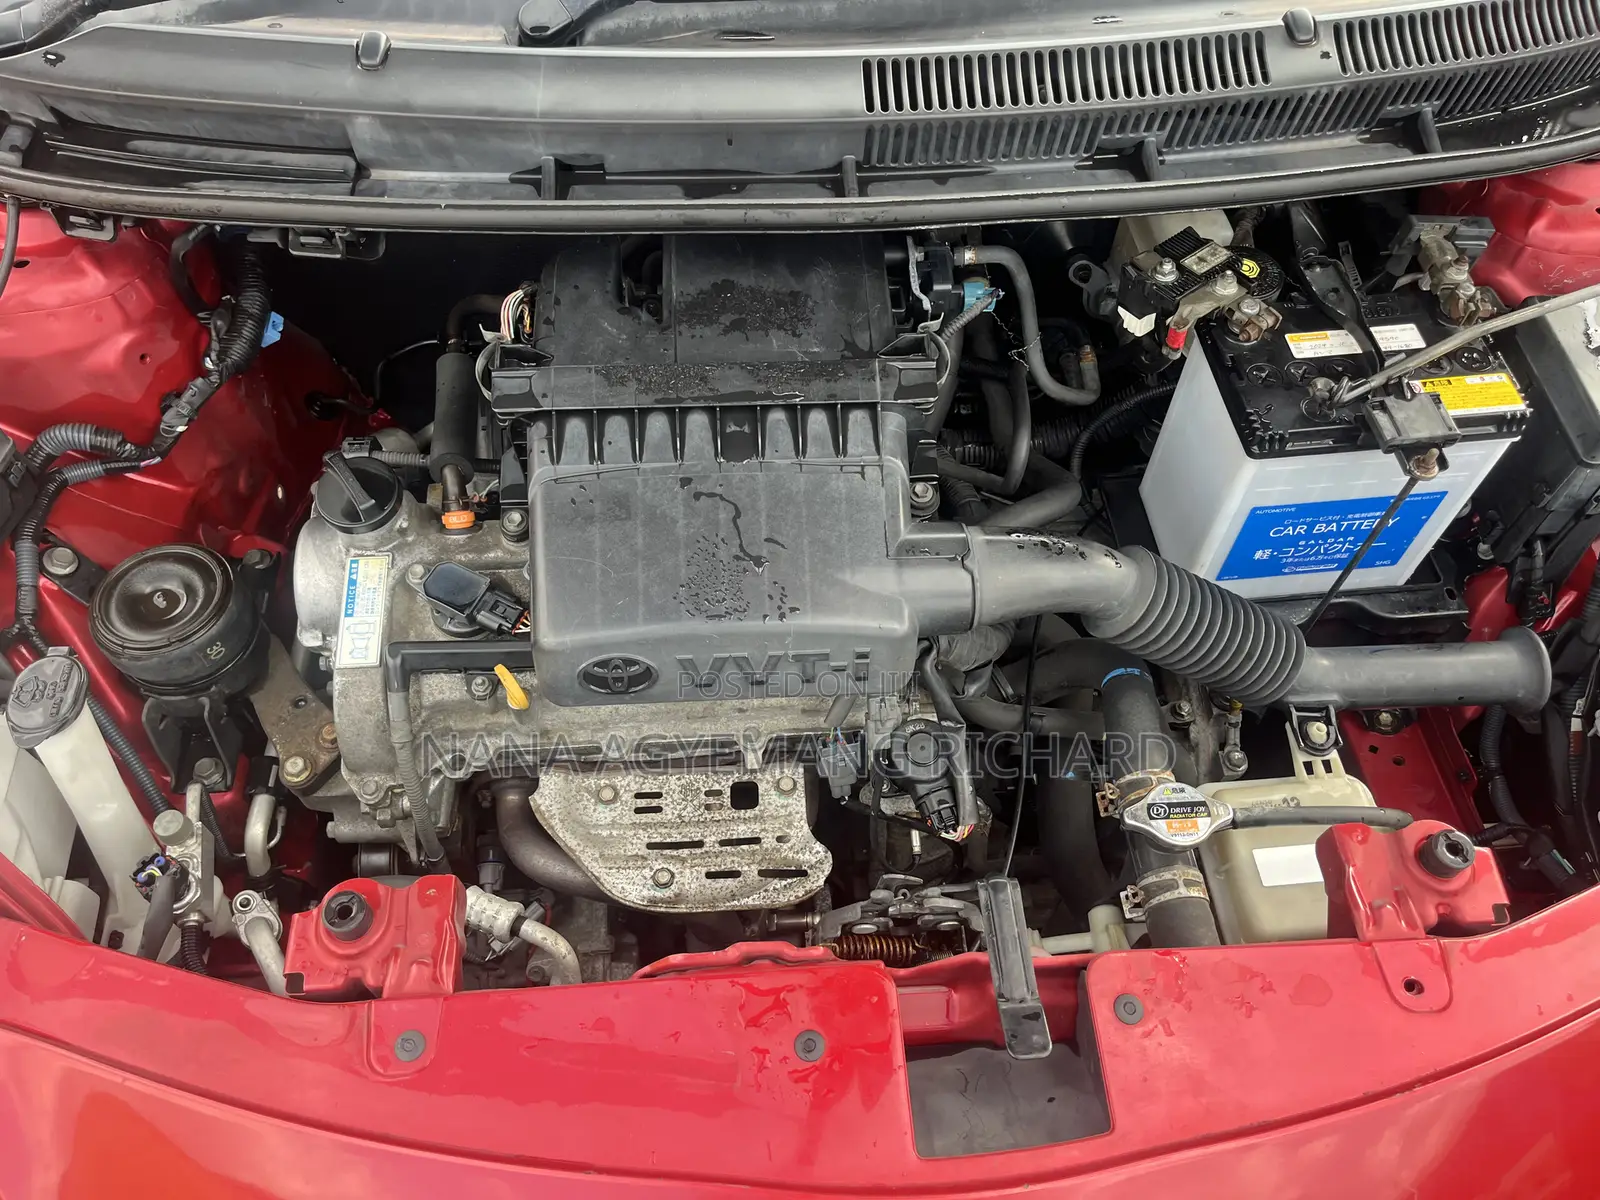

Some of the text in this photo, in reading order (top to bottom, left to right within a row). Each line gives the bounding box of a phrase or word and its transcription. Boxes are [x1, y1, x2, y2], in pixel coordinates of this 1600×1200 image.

[1255, 507, 1296, 515] AUTOMOTIVE
[1269, 524, 1308, 538] CAR
[346, 585, 357, 614] NOTICE
[676, 647, 871, 688] VVT-i
[1170, 806, 1206, 814] DRIVE JOY
